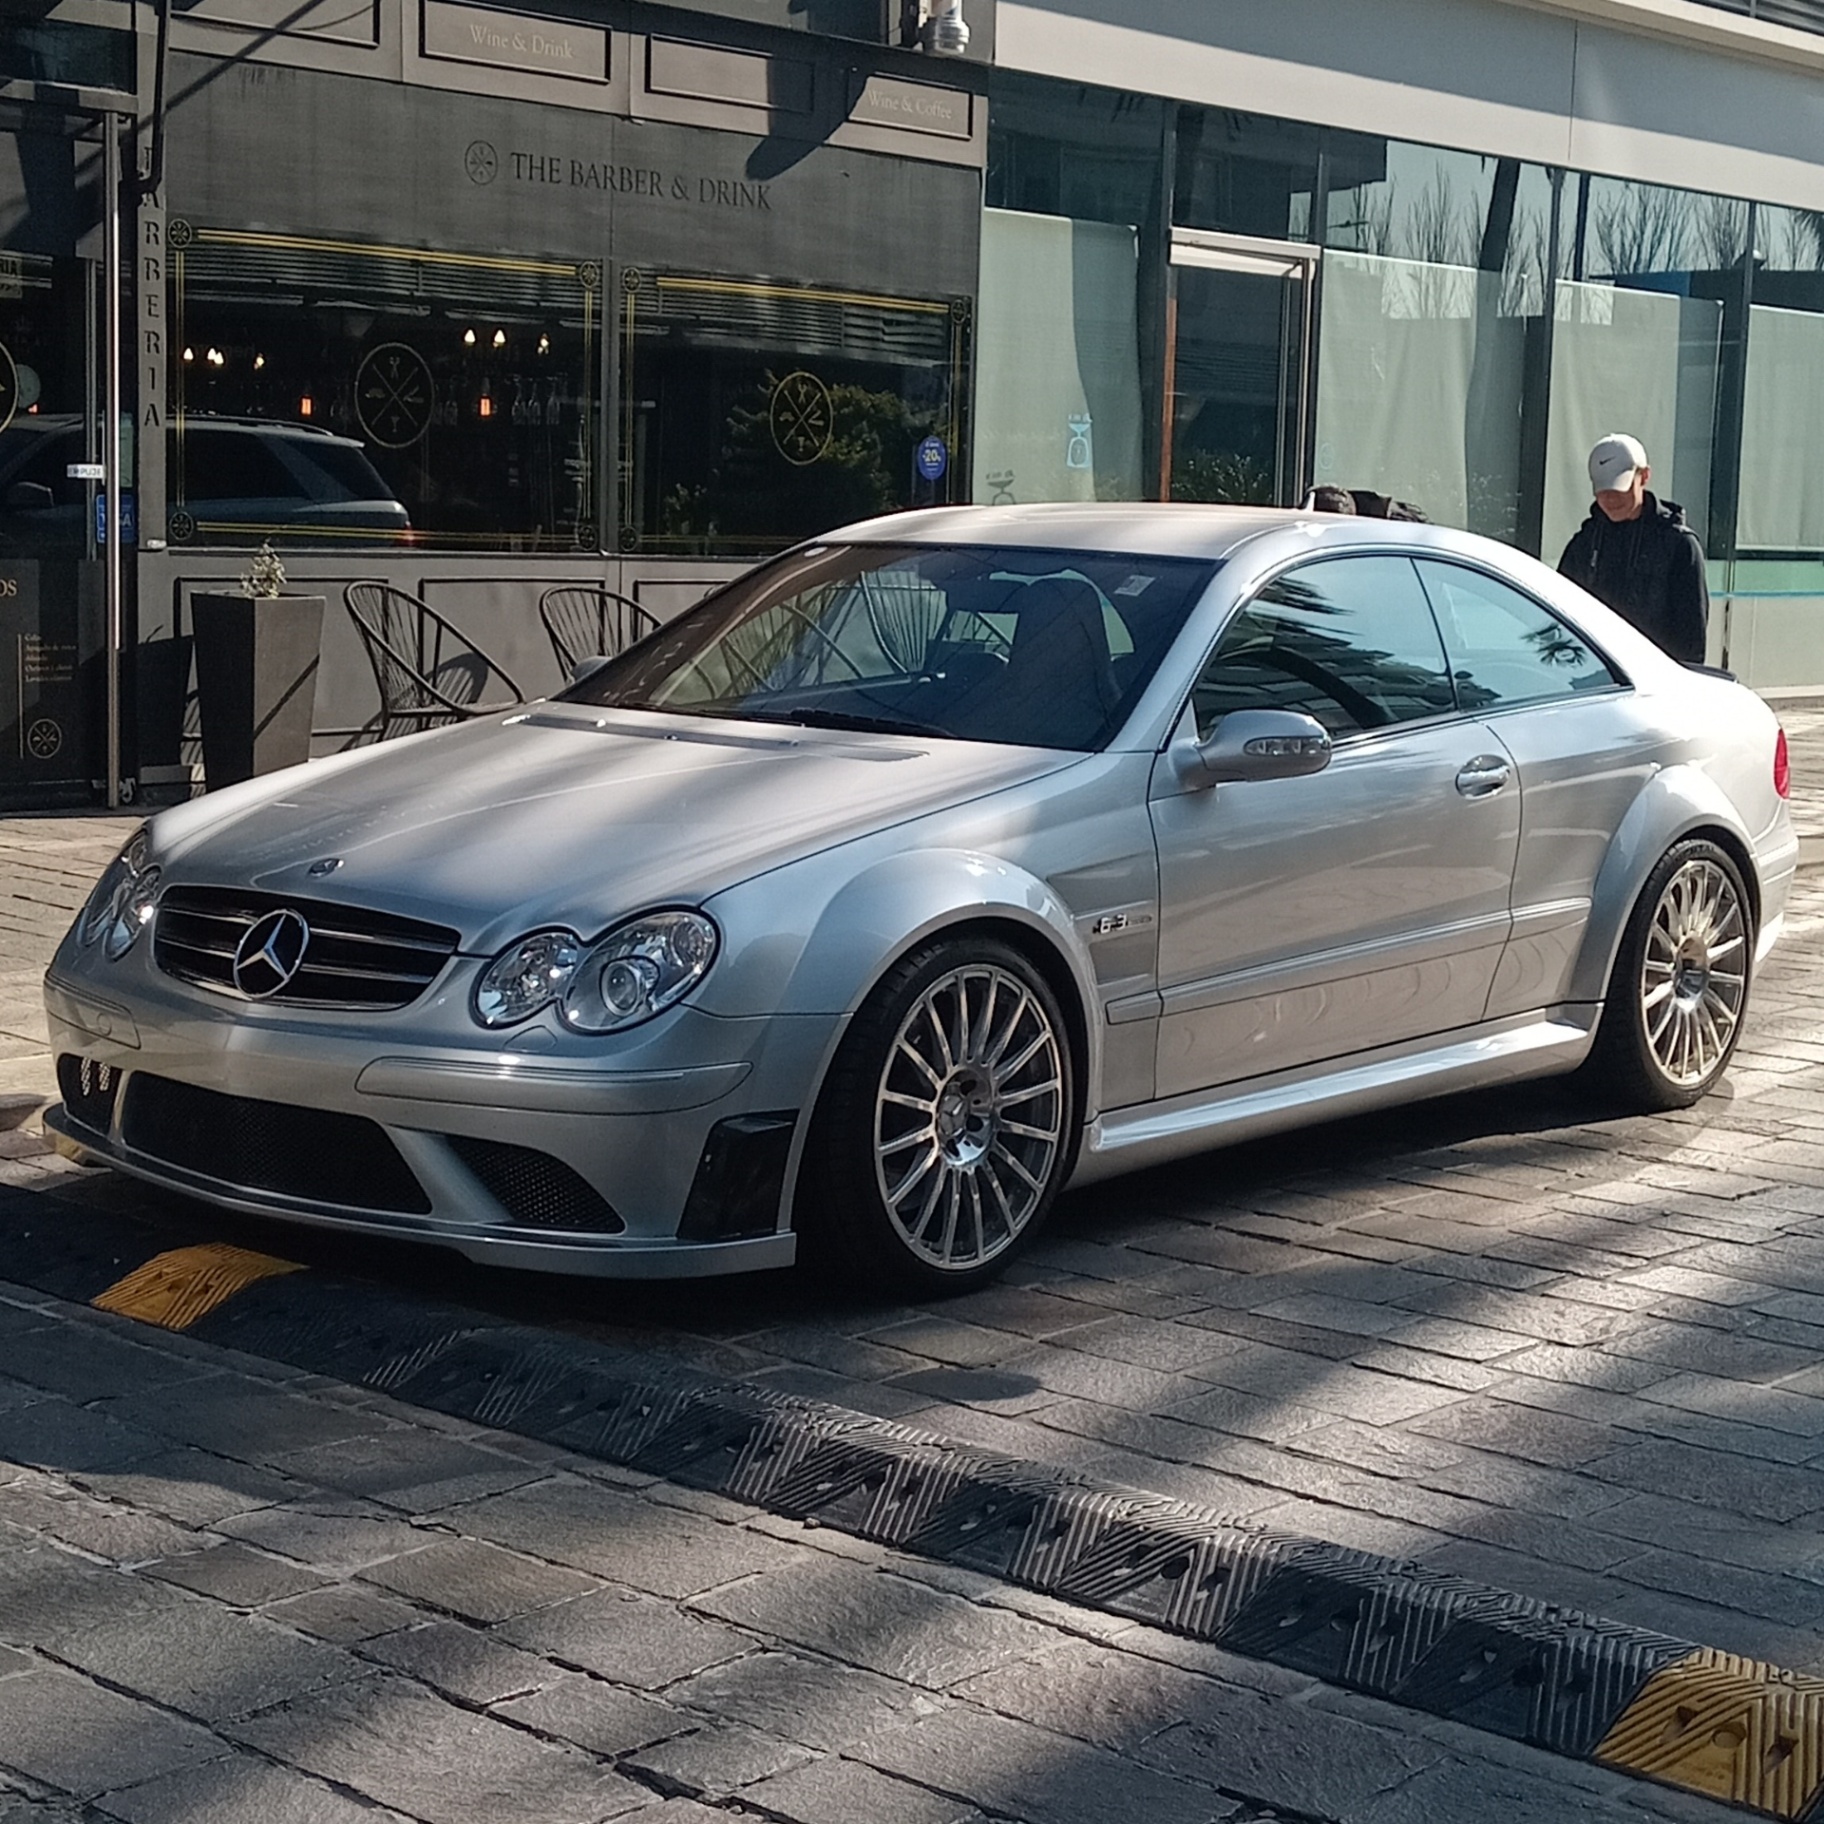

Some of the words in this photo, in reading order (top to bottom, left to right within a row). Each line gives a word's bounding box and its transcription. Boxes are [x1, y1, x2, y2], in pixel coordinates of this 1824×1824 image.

[470, 24, 508, 48] Wine
[512, 32, 527, 52] &
[532, 35, 573, 58] Drink
[868, 89, 899, 110] Wine
[902, 96, 913, 112] &
[916, 100, 952, 119] Coffee
[511, 152, 561, 184] THE
[570, 159, 664, 198] BARBER
[671, 175, 690, 201] &
[700, 177, 772, 211] DRINK
